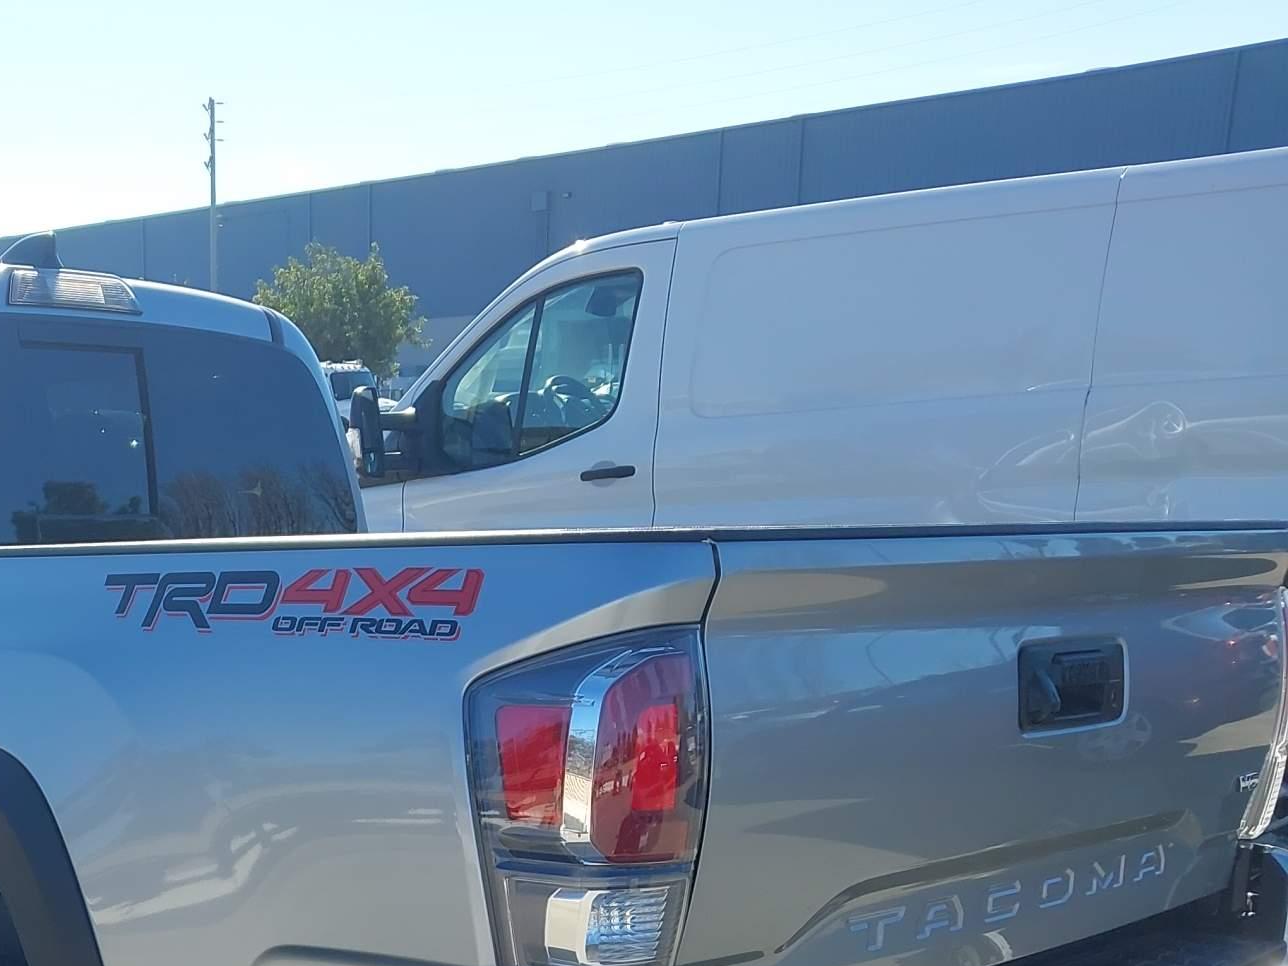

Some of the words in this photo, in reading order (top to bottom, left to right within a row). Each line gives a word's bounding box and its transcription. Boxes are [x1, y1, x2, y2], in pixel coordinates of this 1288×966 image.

[104, 570, 285, 634] TRD
[279, 566, 486, 618] 4X4
[271, 615, 350, 638] OFF
[348, 616, 463, 642] ROAD
[847, 844, 1167, 952] TACOMA
